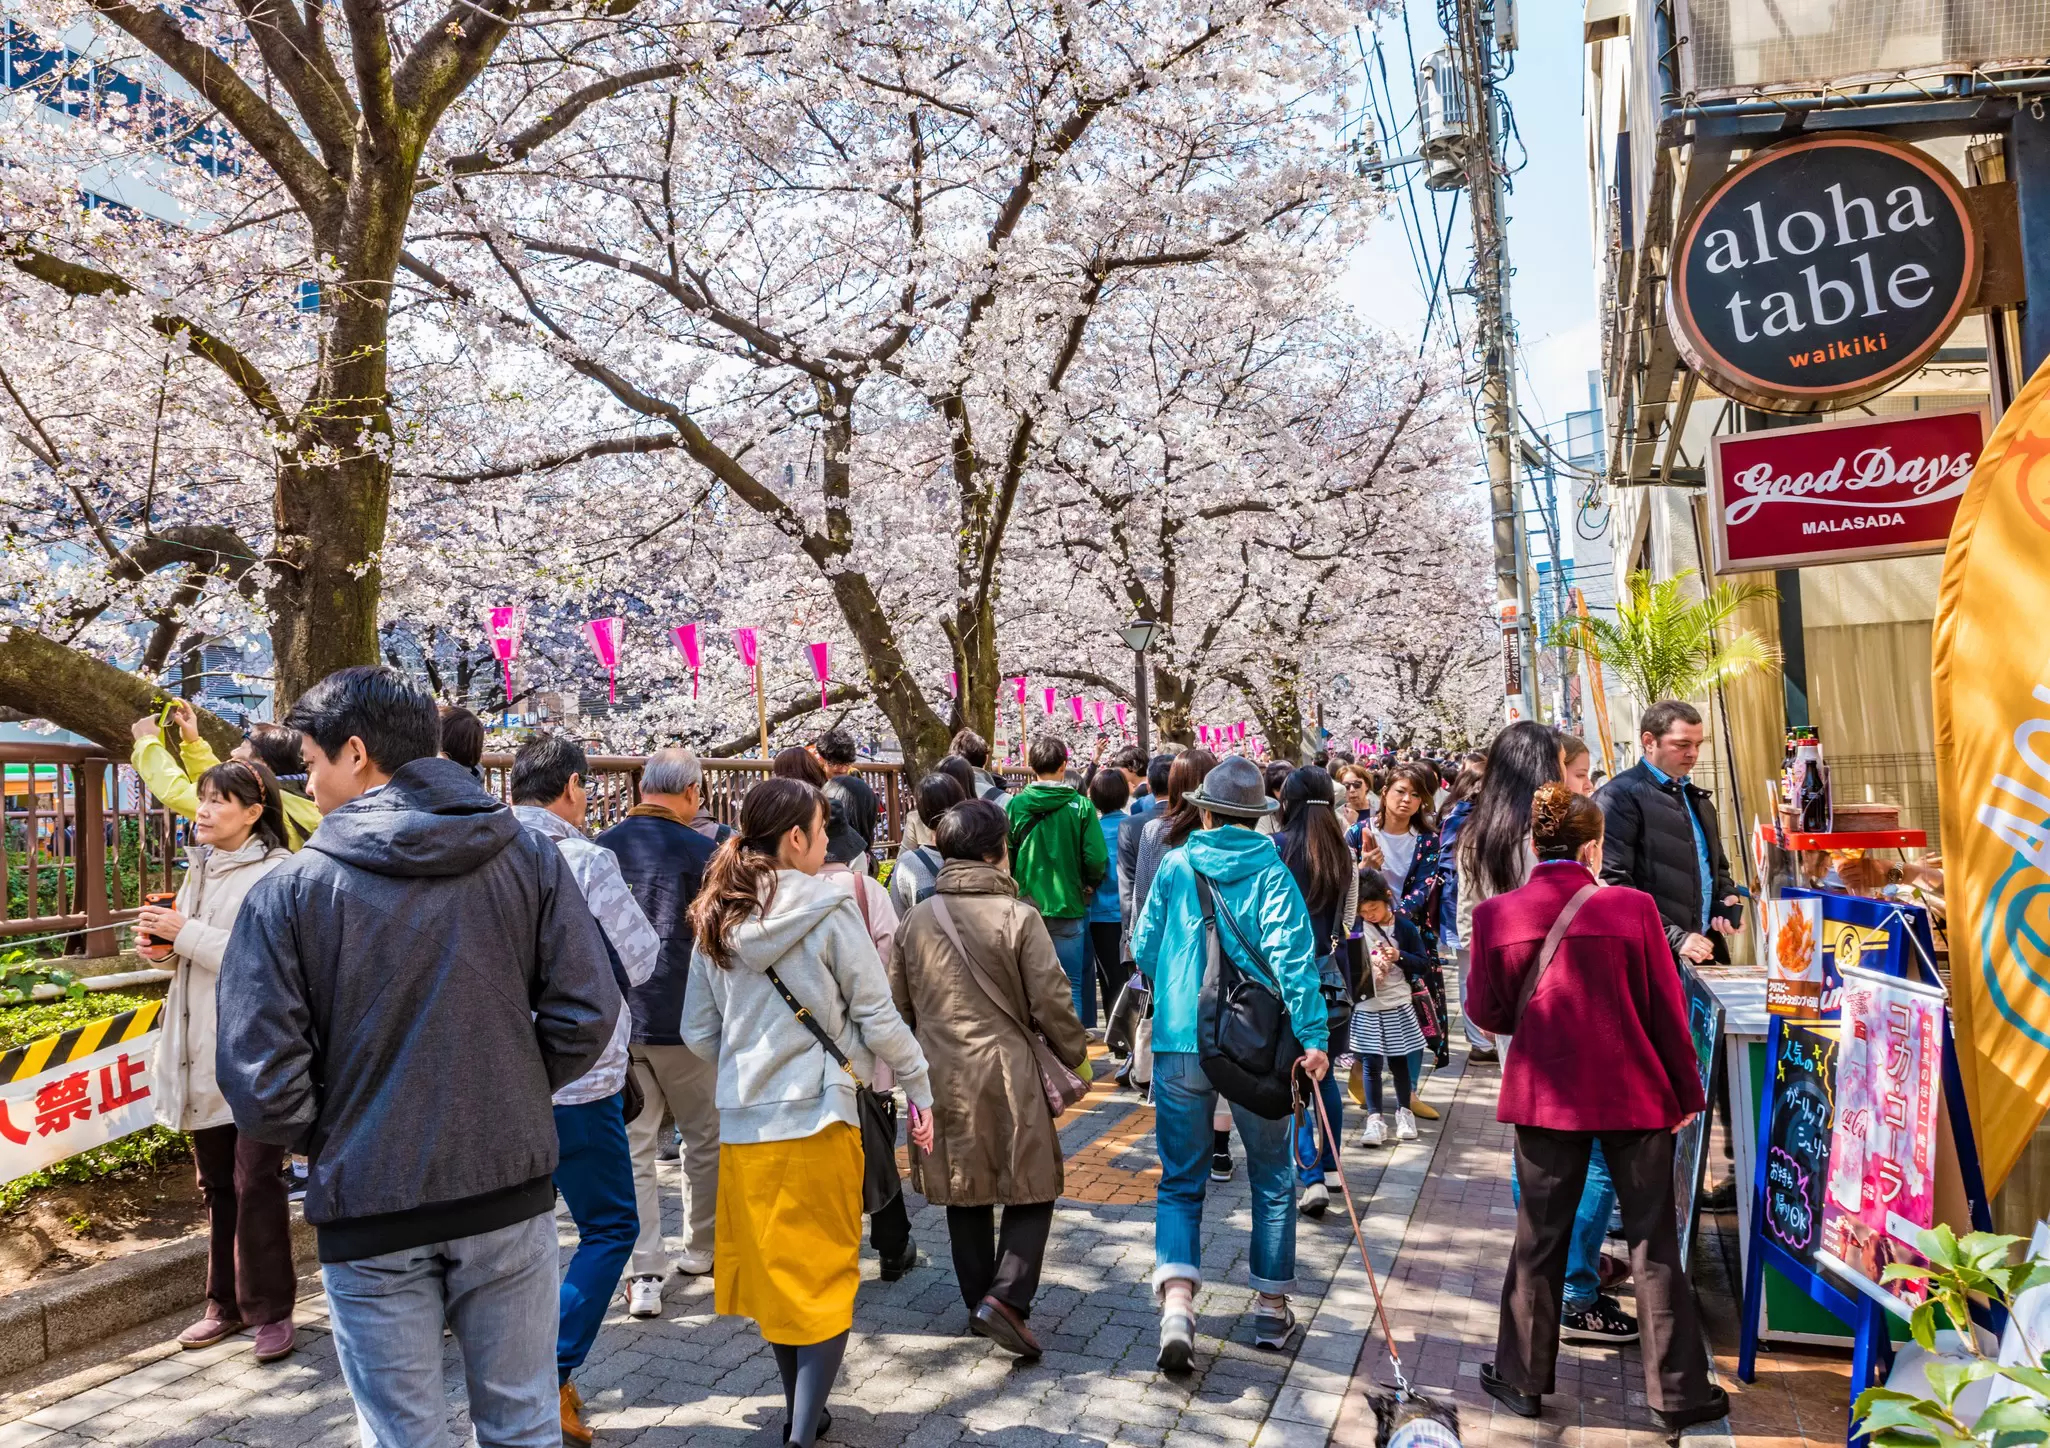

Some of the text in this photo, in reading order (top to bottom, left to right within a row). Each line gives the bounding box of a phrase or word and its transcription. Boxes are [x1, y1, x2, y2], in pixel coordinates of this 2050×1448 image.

[1704, 182, 1934, 274] aloha
[1725, 251, 1934, 344] table
[1789, 332, 1888, 369] waikiki
[1733, 446, 1974, 496] Good Days
[1802, 512, 1905, 535] MALASADA
[1782, 1040, 1814, 1072] 人気の
[1880, 1003, 1912, 1203] コカ・コーラ
[1916, 1021, 1932, 1164] 中目黒の桜と一緒に
[1797, 1126, 1832, 1159] シュリン
[1770, 1161, 1793, 1189] お持ち
